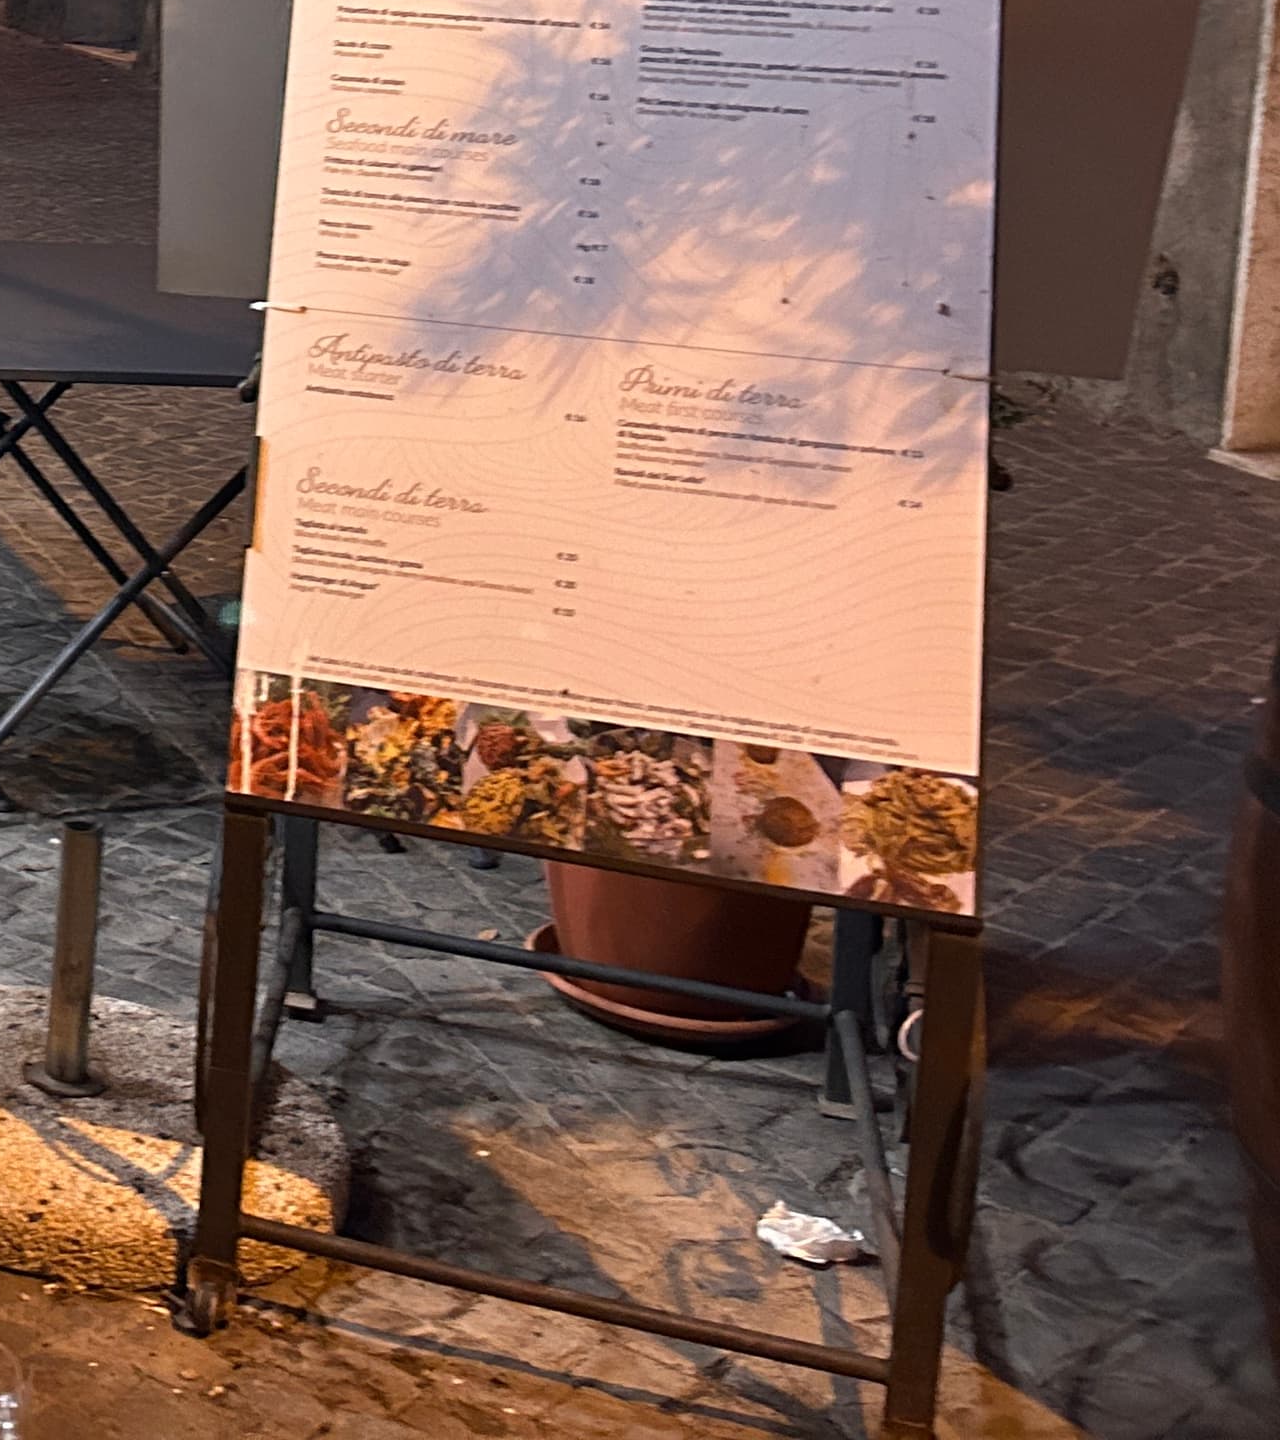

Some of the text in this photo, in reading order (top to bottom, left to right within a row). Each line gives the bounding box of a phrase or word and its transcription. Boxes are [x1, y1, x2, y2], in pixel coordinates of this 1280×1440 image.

[325, 108, 518, 147] Secondi di mare
[432, 350, 461, 373] di
[461, 355, 527, 381] terra
[619, 364, 806, 410] Primi di terra
[296, 465, 489, 513] Secondi di terra
